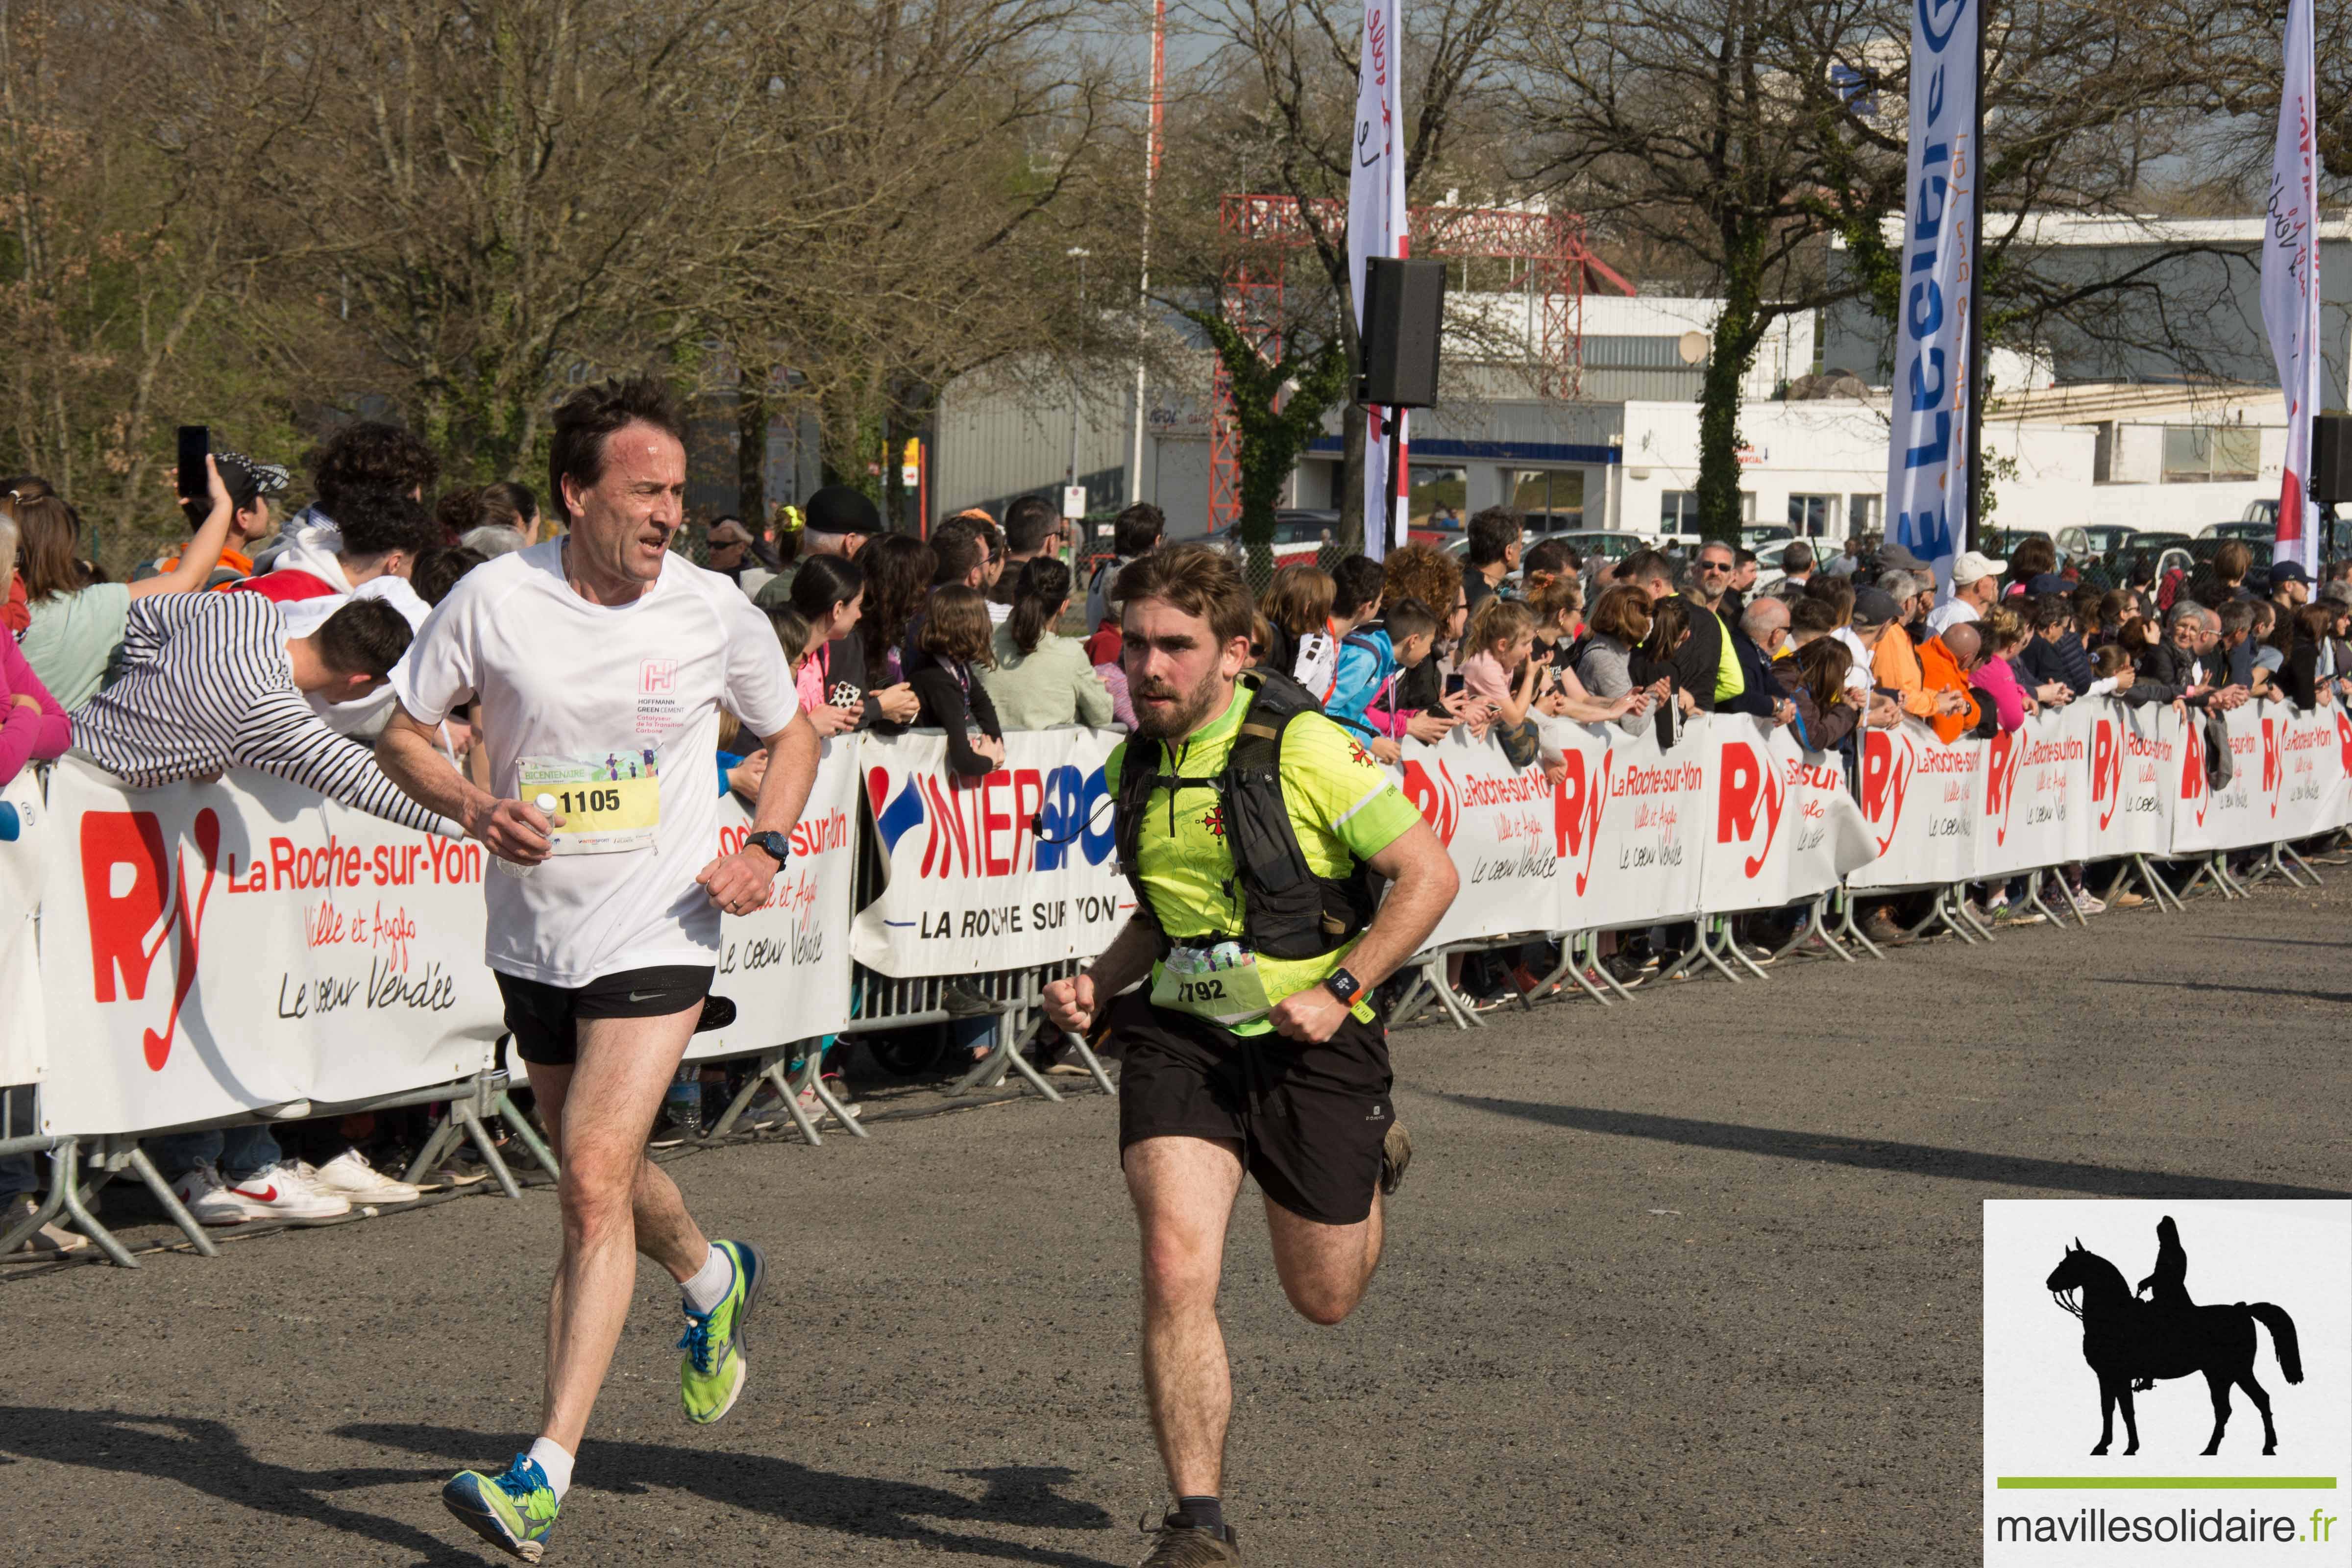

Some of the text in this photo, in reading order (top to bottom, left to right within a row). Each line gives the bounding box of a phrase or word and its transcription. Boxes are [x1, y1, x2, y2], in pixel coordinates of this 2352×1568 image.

[525, 768, 584, 780] BICENTENAIRE
[1916, 753, 1929, 774] La
[2023, 747, 2033, 767] La
[1458, 767, 1552, 808] La Roche-sur-Yo
[1612, 760, 1702, 797] La Roche-sur-Yon
[560, 789, 620, 813] 1105
[1635, 801, 1649, 831] Ville
[1650, 808, 1657, 827] et
[917, 764, 1116, 879] INTERSPO
[228, 833, 480, 893] La Roche-sur-Yon
[1471, 855, 1487, 884] Le
[1517, 844, 1557, 879] Vendée
[1619, 842, 1629, 870] Le
[780, 877, 793, 907] et
[304, 899, 416, 973] Ville et Agglo
[920, 895, 1117, 939] LA ROCHE SUR YON
[719, 933, 735, 975] Le
[278, 972, 308, 1019] Le
[368, 956, 456, 1011] Vendée
